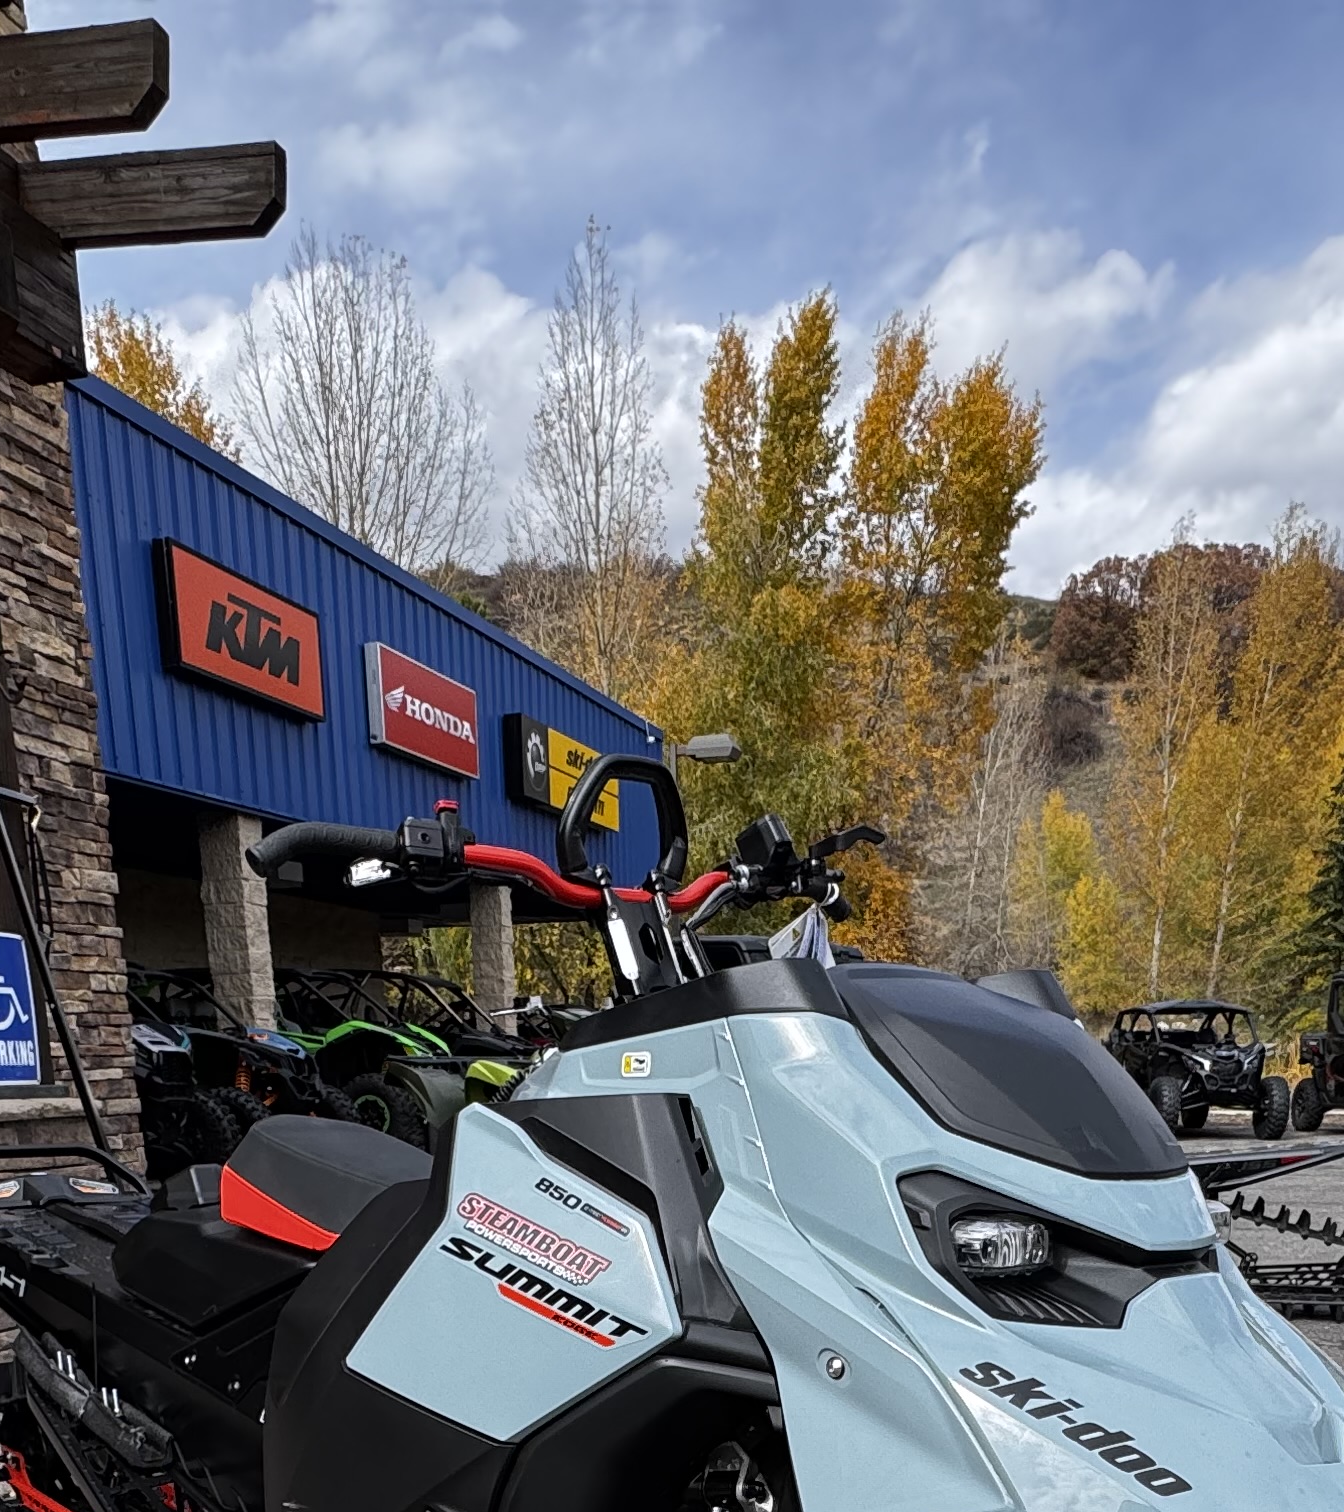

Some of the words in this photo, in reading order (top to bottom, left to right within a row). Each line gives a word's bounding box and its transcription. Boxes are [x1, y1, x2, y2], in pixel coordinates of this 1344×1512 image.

[206, 593, 300, 687] KTM
[404, 693, 476, 744] HONDA
[535, 1177, 583, 1210] 850
[458, 1194, 611, 1277] STEAMBOAT
[464, 1220, 563, 1276] POWERSPORTS
[440, 1237, 648, 1337] SUMMIT
[959, 1361, 1193, 1497] ski-doo
